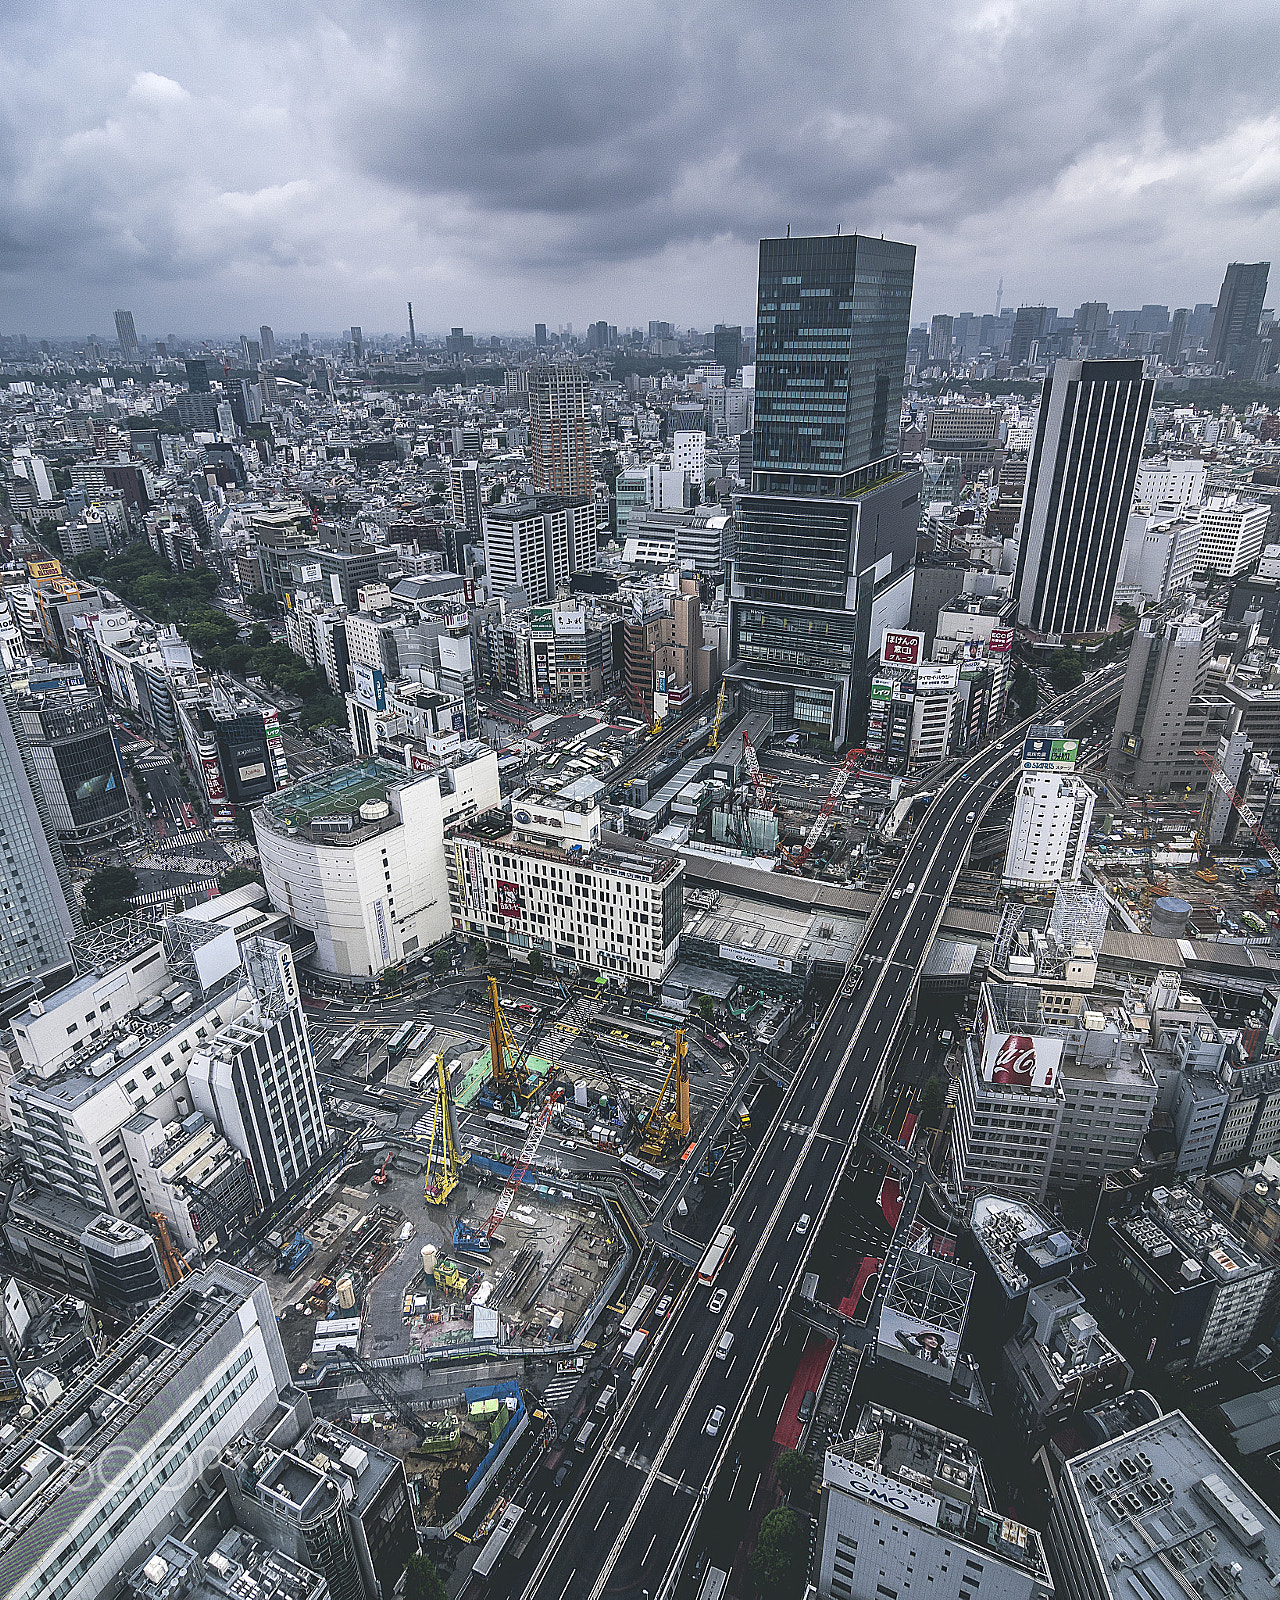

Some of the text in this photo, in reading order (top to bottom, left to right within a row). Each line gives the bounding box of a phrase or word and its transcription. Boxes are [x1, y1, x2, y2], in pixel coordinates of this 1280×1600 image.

[887, 635, 918, 646] ほけんの
[889, 654, 913, 662] グループ
[873, 688, 891, 696] レイク
[532, 814, 562, 828] 東急
[830, 1459, 934, 1508] すべての人にインターネット
[849, 1480, 910, 1510] GMO
